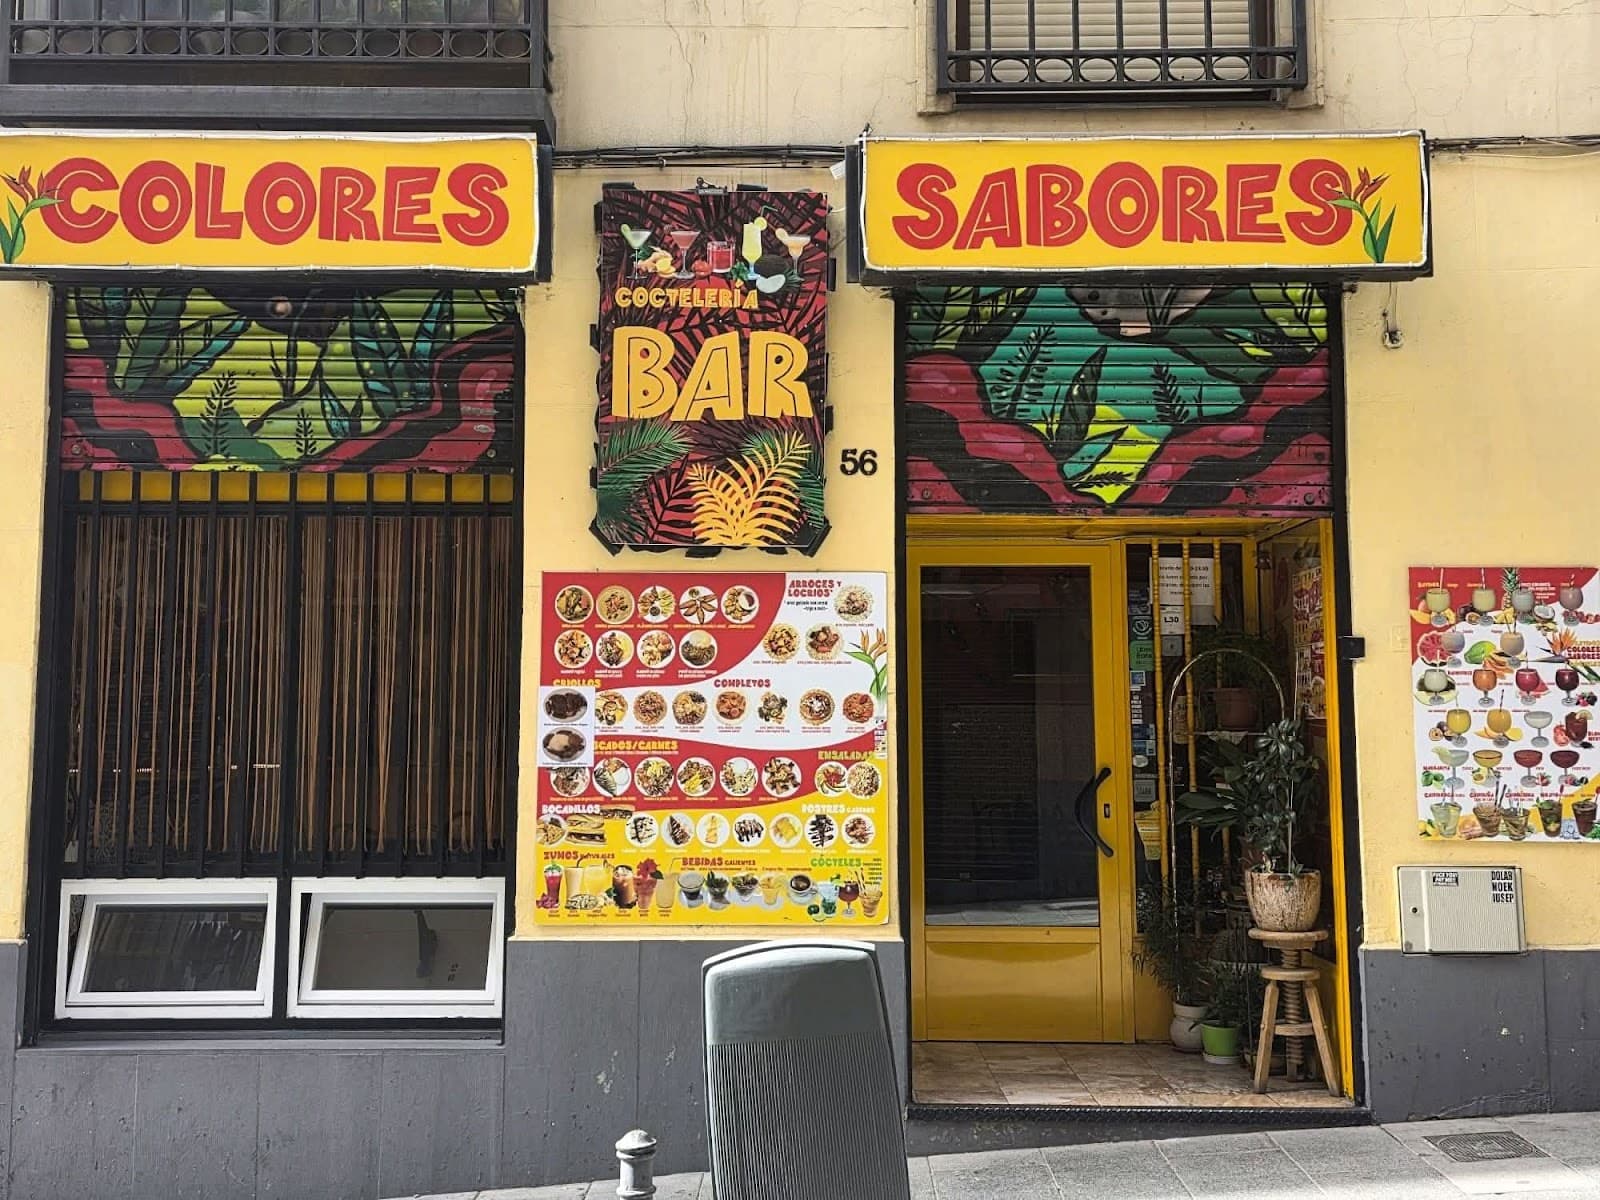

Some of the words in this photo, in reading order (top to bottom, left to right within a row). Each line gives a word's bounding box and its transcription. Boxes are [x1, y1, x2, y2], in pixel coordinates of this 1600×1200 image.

[40, 157, 510, 247] COLORES
[892, 158, 1353, 250] SABORES
[614, 279, 760, 309] COCTELERÍA
[612, 326, 814, 421] BAR
[840, 449, 878, 476] 56
[789, 580, 835, 589] ARROCES
[714, 679, 771, 688] COMPLETOS
[594, 740, 678, 751] CADOS/CARNES
[542, 805, 600, 814] BOCADILLOS
[801, 804, 845, 814] POSTRES
[543, 851, 578, 860] ZUMOS
[682, 857, 723, 866] BEBIDAS
